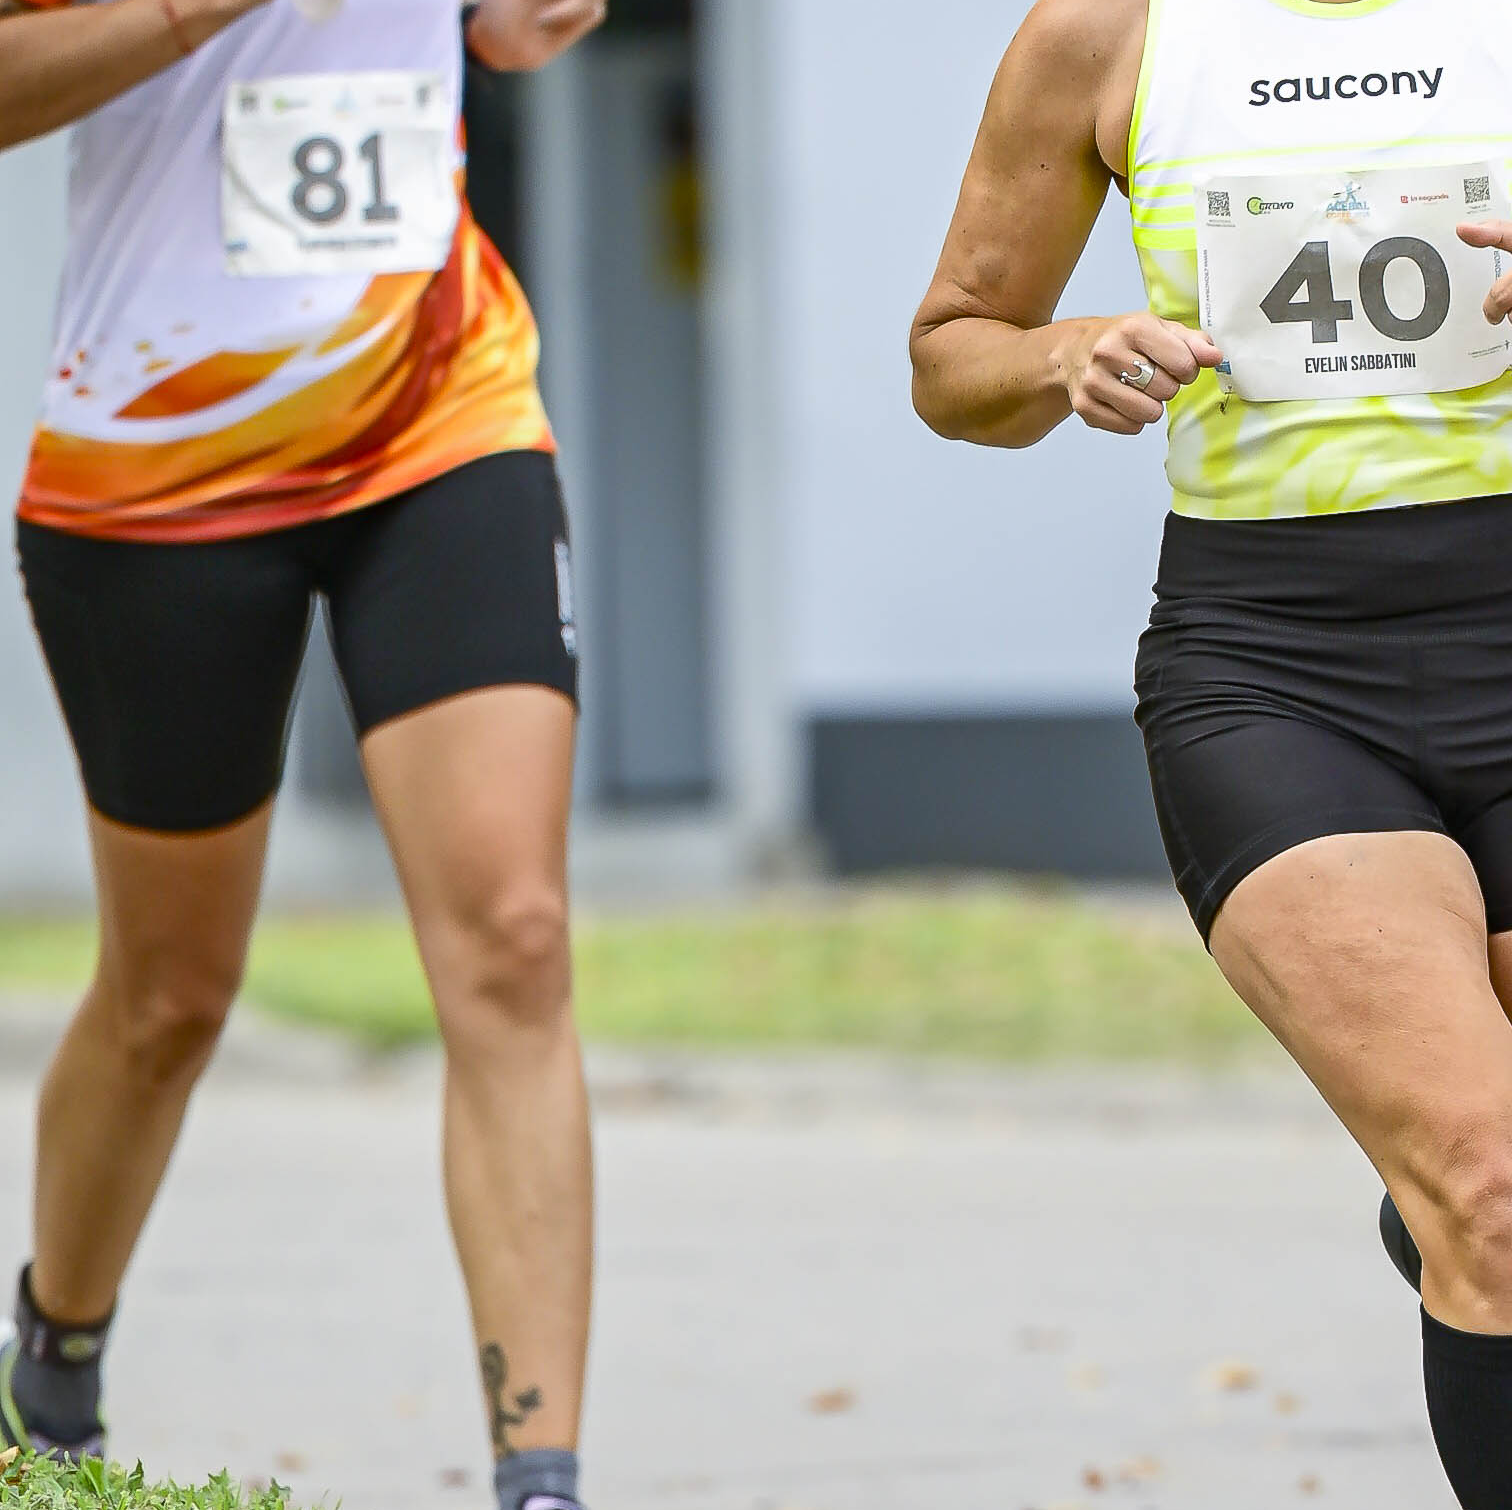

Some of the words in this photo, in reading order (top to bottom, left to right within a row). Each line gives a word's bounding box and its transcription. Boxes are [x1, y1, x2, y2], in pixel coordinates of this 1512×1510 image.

[1248, 66, 1444, 107] saucony
[292, 134, 400, 223] 81
[1259, 236, 1451, 343] 40
[1305, 356, 1348, 374] EVELIN
[1350, 352, 1417, 371] SABBATINI
